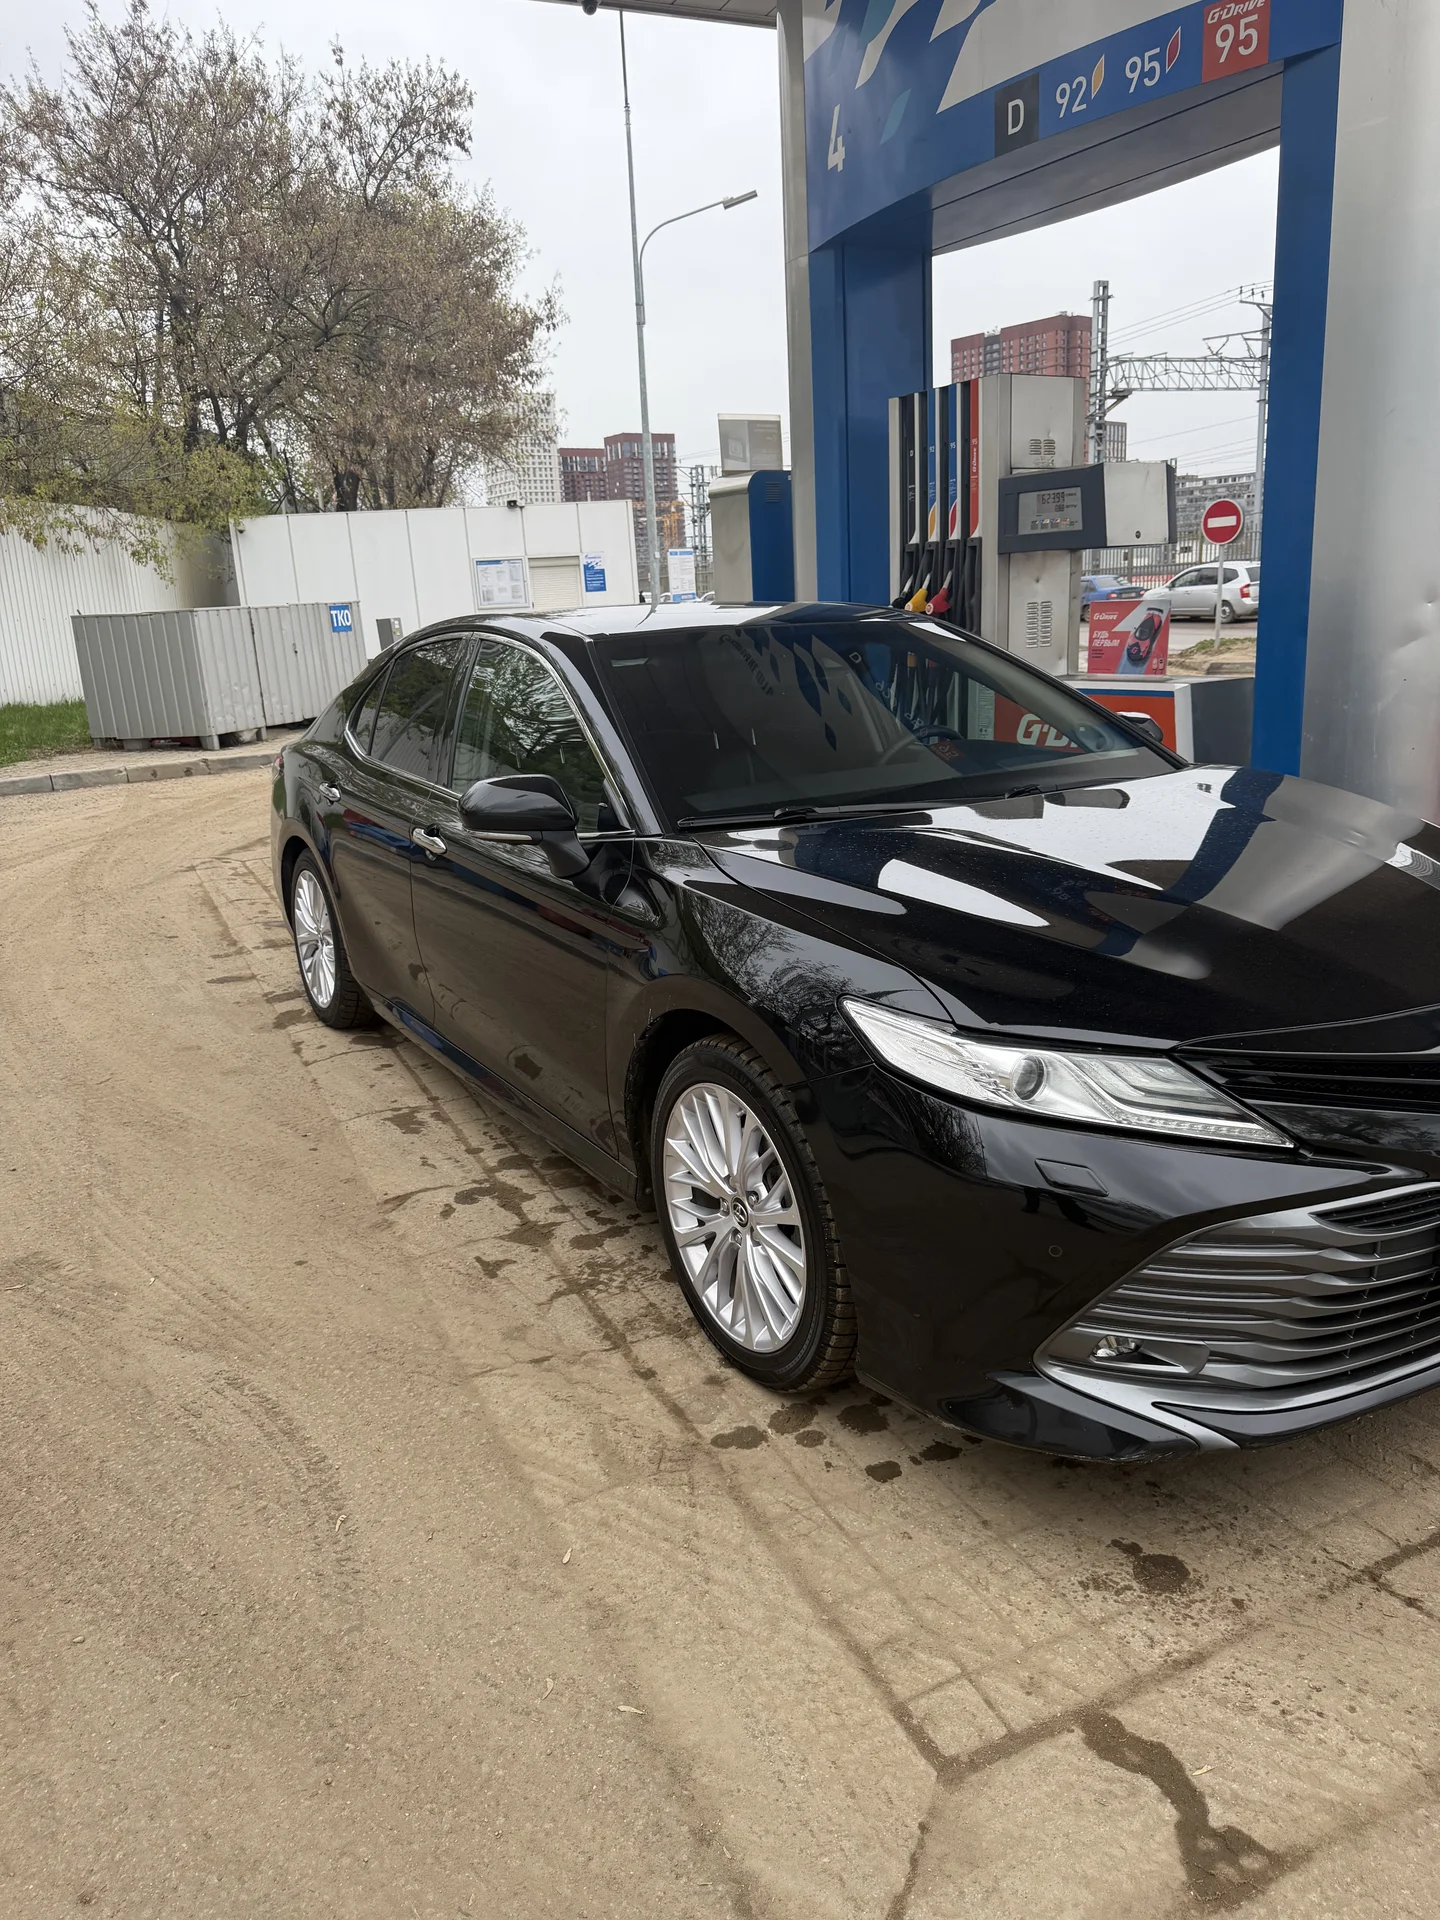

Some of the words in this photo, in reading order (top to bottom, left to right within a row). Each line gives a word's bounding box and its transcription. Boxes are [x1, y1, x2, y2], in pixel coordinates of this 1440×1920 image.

[1215, 13, 1258, 63] 95
[1125, 47, 1161, 94] 95
[1055, 75, 1087, 118] 92
[1008, 98, 1025, 136] D
[827, 103, 846, 172] 4
[330, 609, 352, 627] ТКО
[1092, 630, 1109, 639] БУДЬ
[1092, 639, 1120, 647] ПЕРВЫМ
